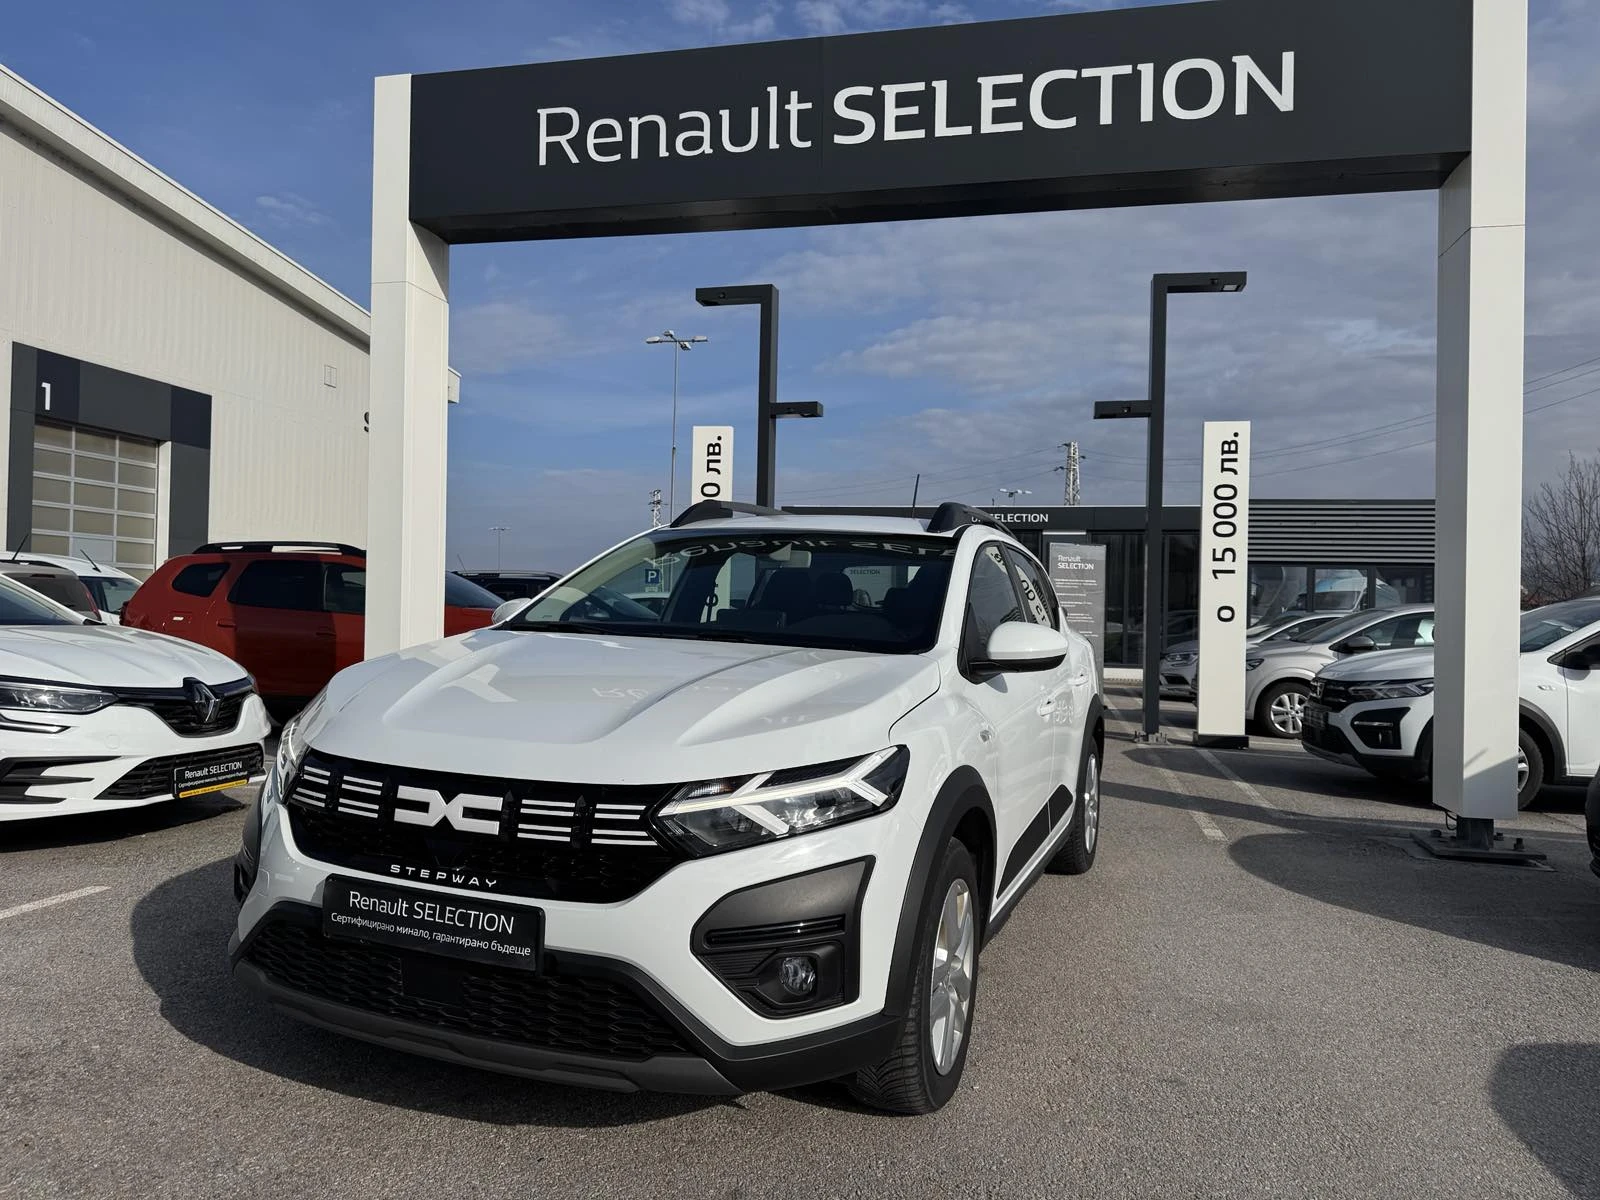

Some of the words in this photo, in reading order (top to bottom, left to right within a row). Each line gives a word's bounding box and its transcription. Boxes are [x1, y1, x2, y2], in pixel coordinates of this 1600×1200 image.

[537, 86, 813, 166] Renault
[833, 51, 1295, 145] SELECTION
[41, 382, 51, 411] 1
[706, 435, 722, 475] лв.
[1220, 431, 1239, 475] лв.
[990, 513, 1049, 523] ELECTION
[1213, 483, 1238, 538] 000
[648, 570, 658, 583] P
[1057, 562, 1095, 570] SELECTION
[1212, 547, 1236, 580] 15
[184, 768, 209, 779] Renault
[209, 761, 242, 774] SELECTION
[390, 864, 497, 888] STEPWAY
[349, 891, 409, 918] Renault
[413, 901, 515, 935] SELECTION
[331, 912, 395, 932] Сертифицирано
[396, 925, 431, 940] минало,
[432, 932, 489, 949] гарантирано
[490, 940, 531, 957] бъдеще
